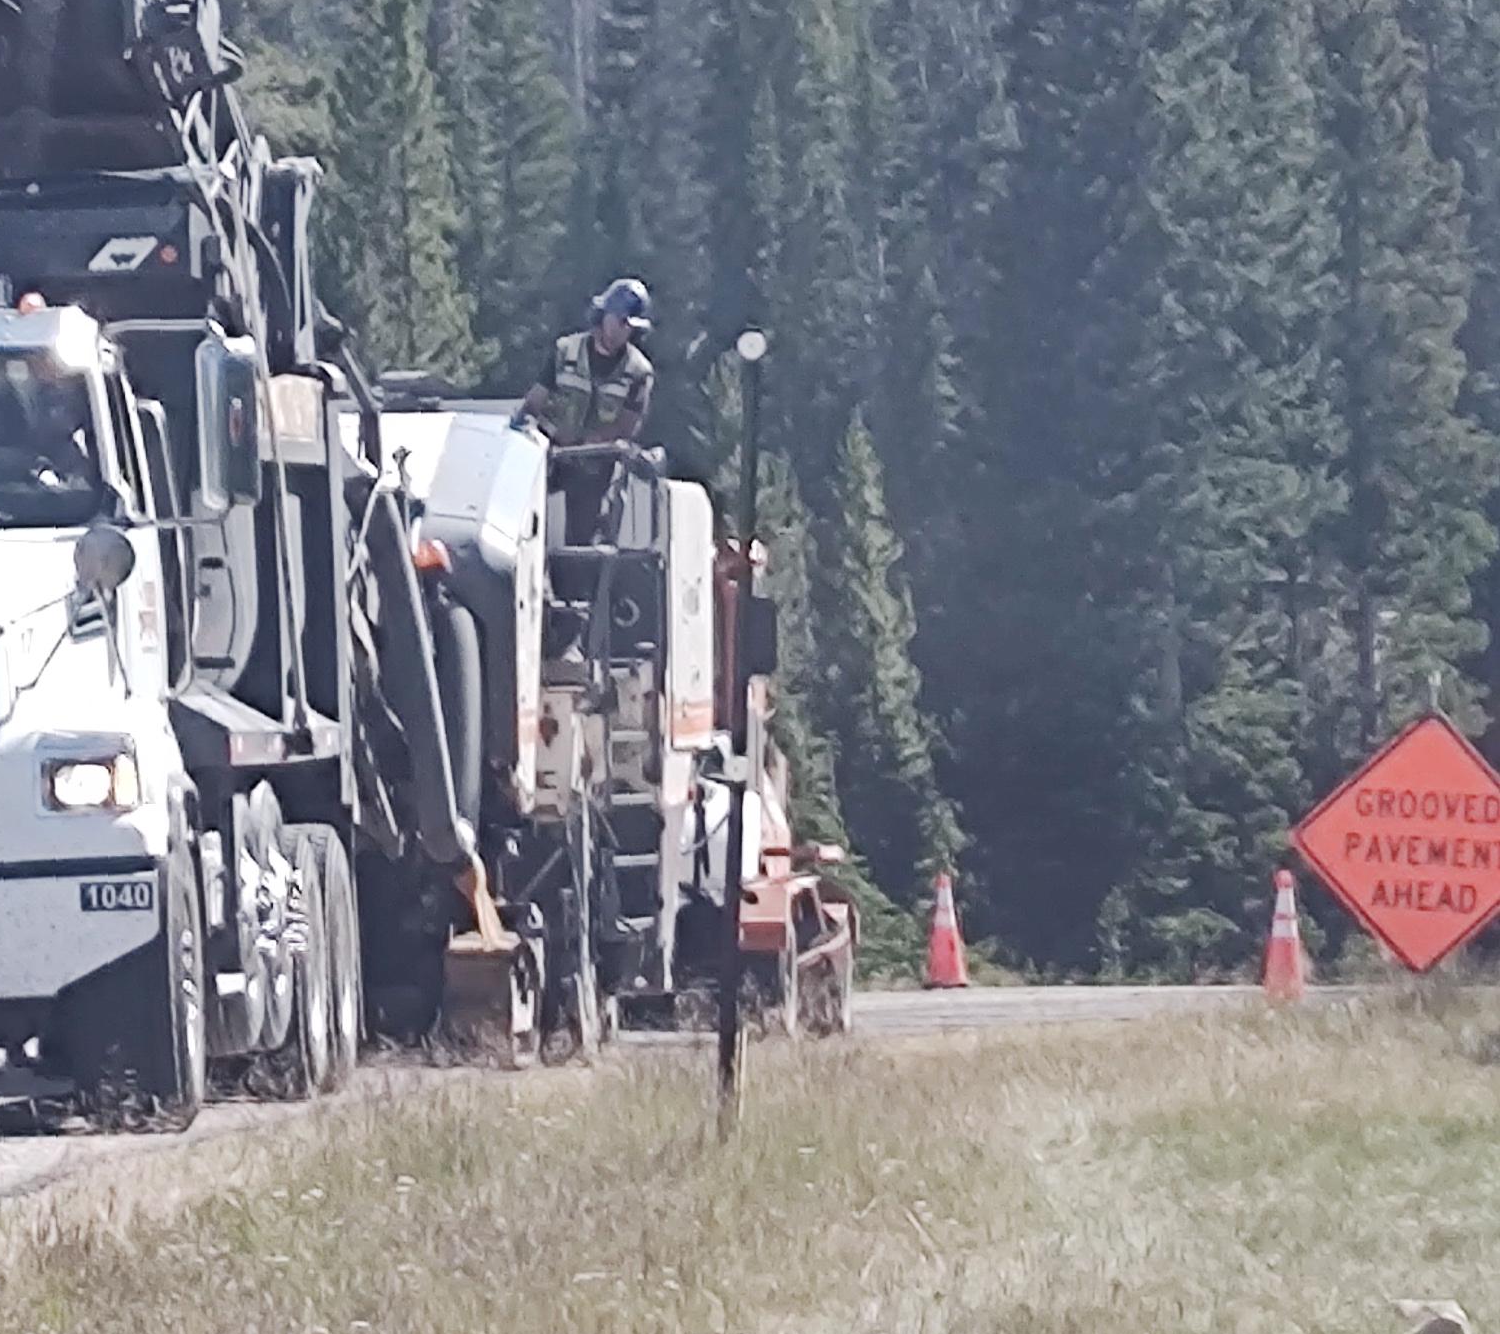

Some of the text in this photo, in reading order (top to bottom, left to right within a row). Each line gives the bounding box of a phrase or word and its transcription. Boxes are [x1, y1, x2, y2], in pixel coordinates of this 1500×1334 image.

[1355, 788, 1500, 824] GROOVED
[88, 883, 150, 908] 1040
[1371, 879, 1477, 914] AHEAD
